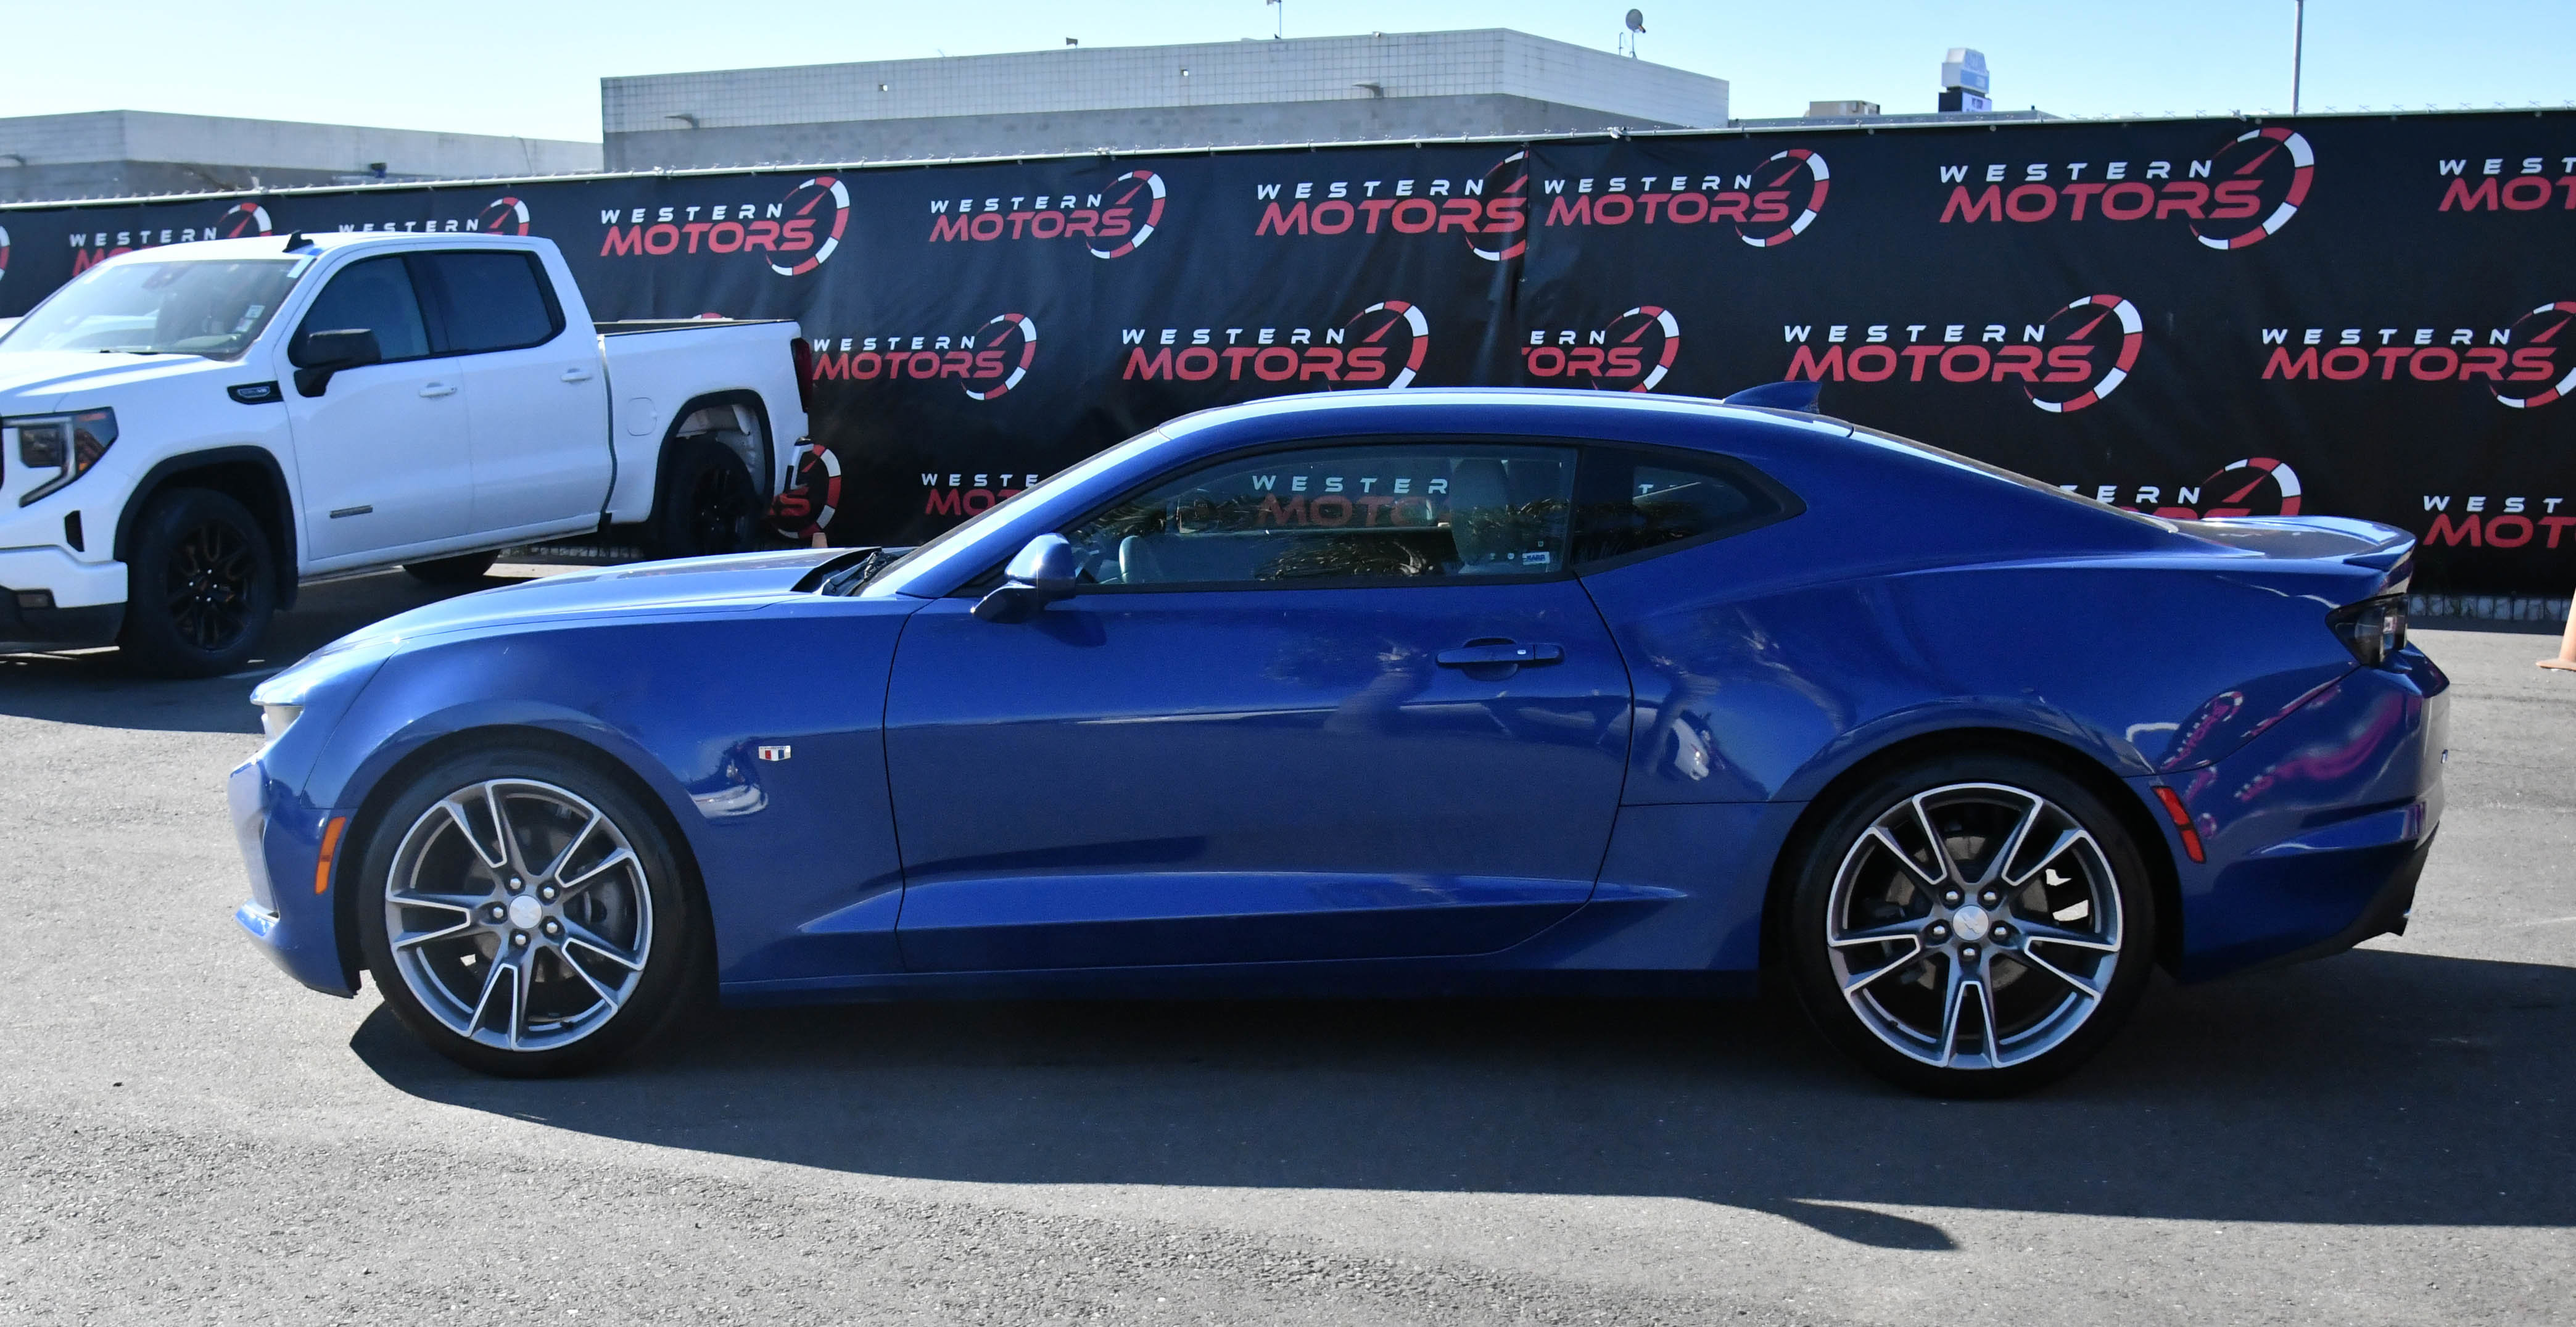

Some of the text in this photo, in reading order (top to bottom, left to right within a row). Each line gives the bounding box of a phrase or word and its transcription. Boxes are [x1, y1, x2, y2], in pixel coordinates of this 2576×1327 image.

[1940, 160, 2211, 183] WESTERN
[2440, 157, 2576, 175] WEST
[1258, 179, 1484, 200] WESTERN
[1544, 175, 1751, 194] WESTERN
[2438, 176, 2576, 211] MOT
[931, 194, 1102, 213] WESTERN
[1546, 191, 1790, 226] MOTORS
[1940, 180, 2263, 223] MOTORS
[601, 203, 783, 224] WESTERN
[1256, 197, 1525, 236] MOTORS
[339, 218, 479, 233] WESTERN
[930, 209, 1133, 241] MOTORS
[70, 227, 217, 247] WESTERN
[601, 218, 815, 256] MOTORS
[814, 336, 975, 352] WESTERN
[1123, 328, 1345, 344] WESTERN
[1784, 325, 2045, 342] WESTERN
[2262, 329, 2510, 345] WESTERN
[813, 350, 1004, 381] MOTORS
[1123, 347, 1387, 381] MOTORS
[1522, 346, 1643, 377] ORS
[1785, 345, 2094, 382] MOTORS
[2262, 346, 2556, 381] MOTORS
[922, 473, 1039, 487] WESTE
[1252, 475, 1448, 494] WESTER
[2424, 495, 2563, 513] WEST
[2423, 513, 2576, 548] MOT
